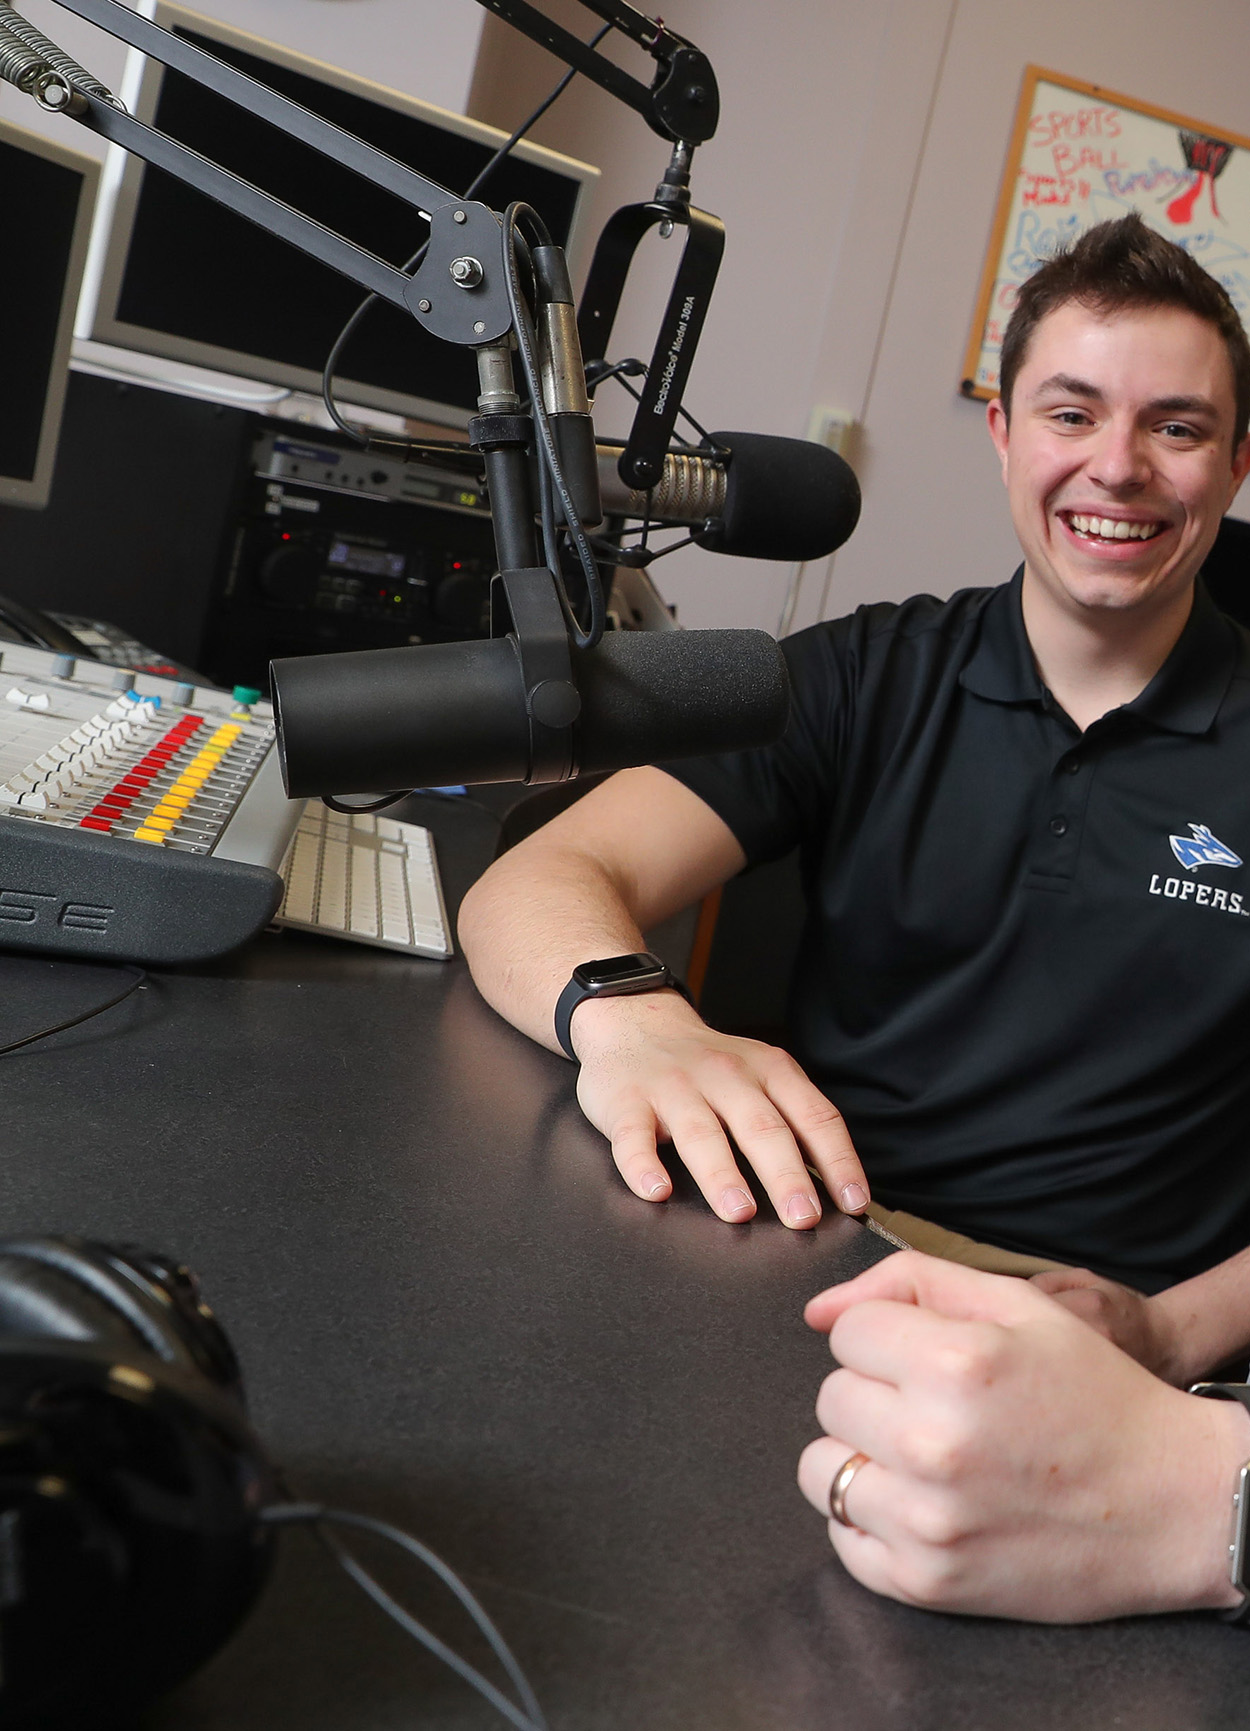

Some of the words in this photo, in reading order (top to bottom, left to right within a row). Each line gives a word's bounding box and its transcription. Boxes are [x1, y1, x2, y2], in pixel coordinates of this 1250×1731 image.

[1052, 144, 1129, 179] BALL
[510, 268, 519, 294] CABLE
[515, 302, 533, 362] MICROPHONE
[671, 321, 688, 352] Model
[680, 296, 696, 321] 309A
[530, 368, 547, 421] BALANCED
[544, 428, 563, 482] MINIATURE
[560, 489, 579, 527] SHIELD
[577, 533, 596, 580] BRAIDED
[1149, 874, 1244, 914] LOPERS
